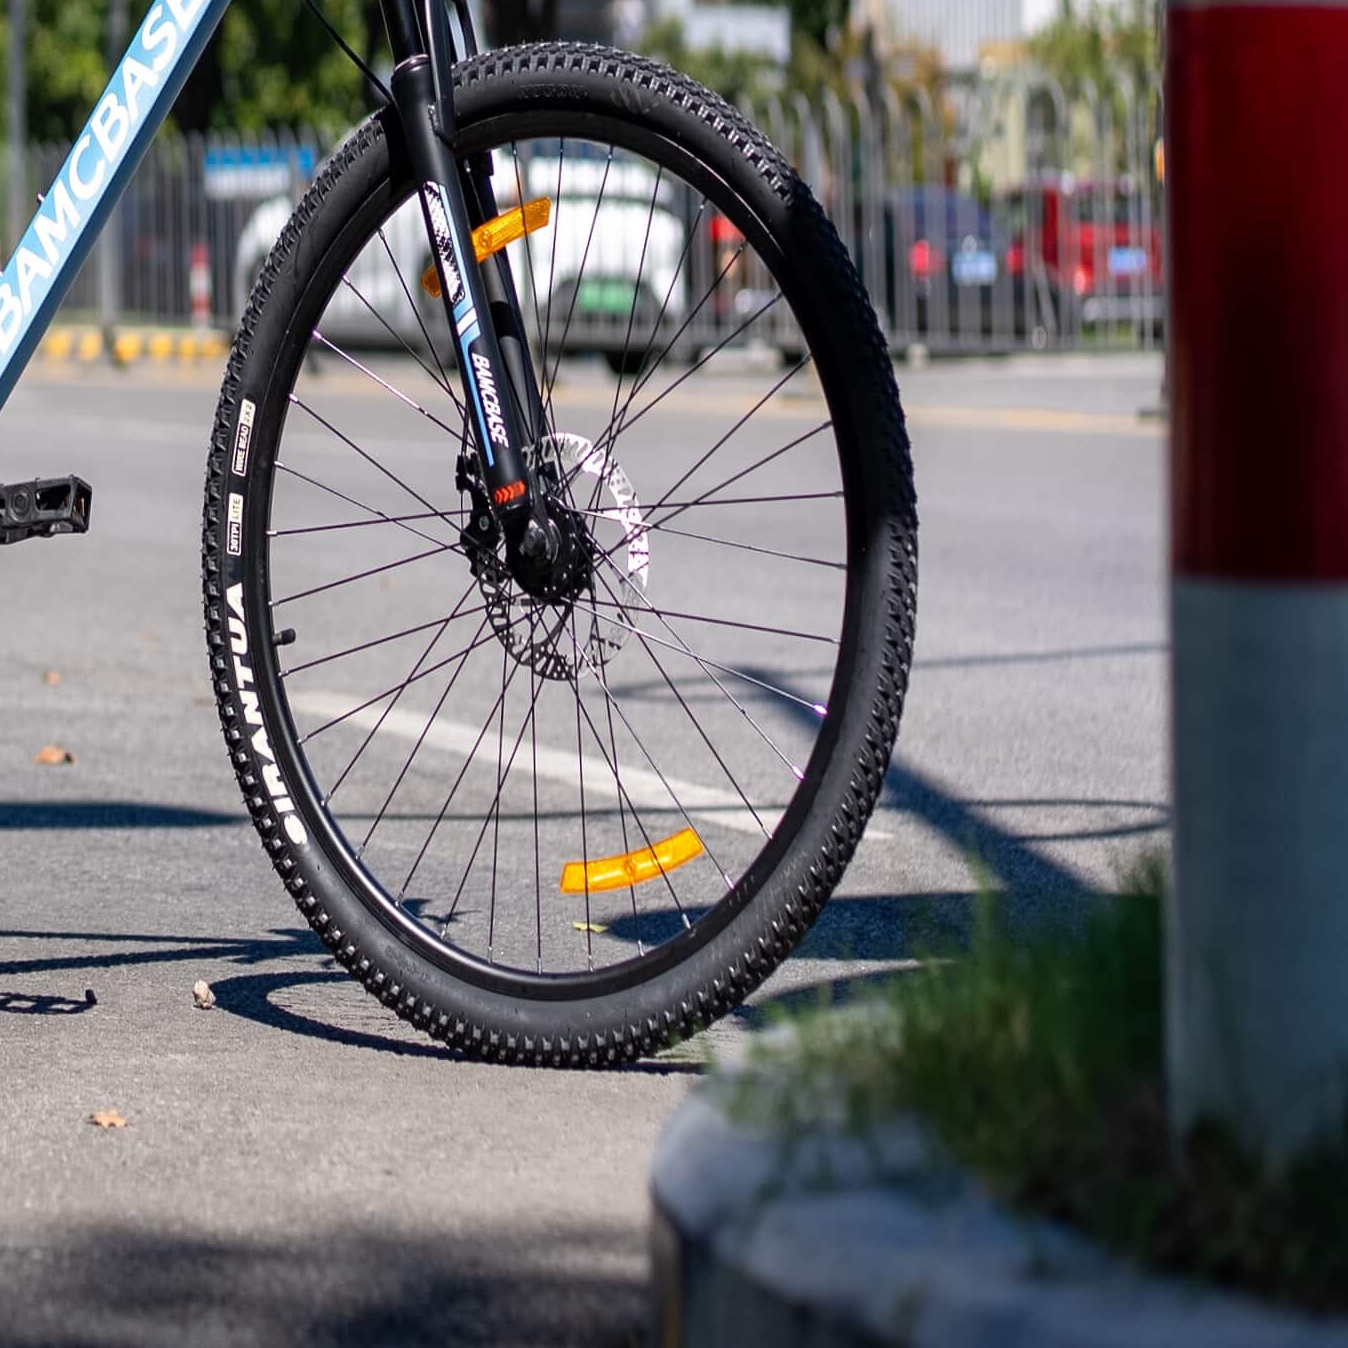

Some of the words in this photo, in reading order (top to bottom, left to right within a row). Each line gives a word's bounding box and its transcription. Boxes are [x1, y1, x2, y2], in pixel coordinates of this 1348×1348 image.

[472, 353, 509, 448] BAMCBASE
[238, 425, 249, 449] BEAD
[232, 498, 240, 520] LITE
[226, 582, 308, 845] SIRANTUA
